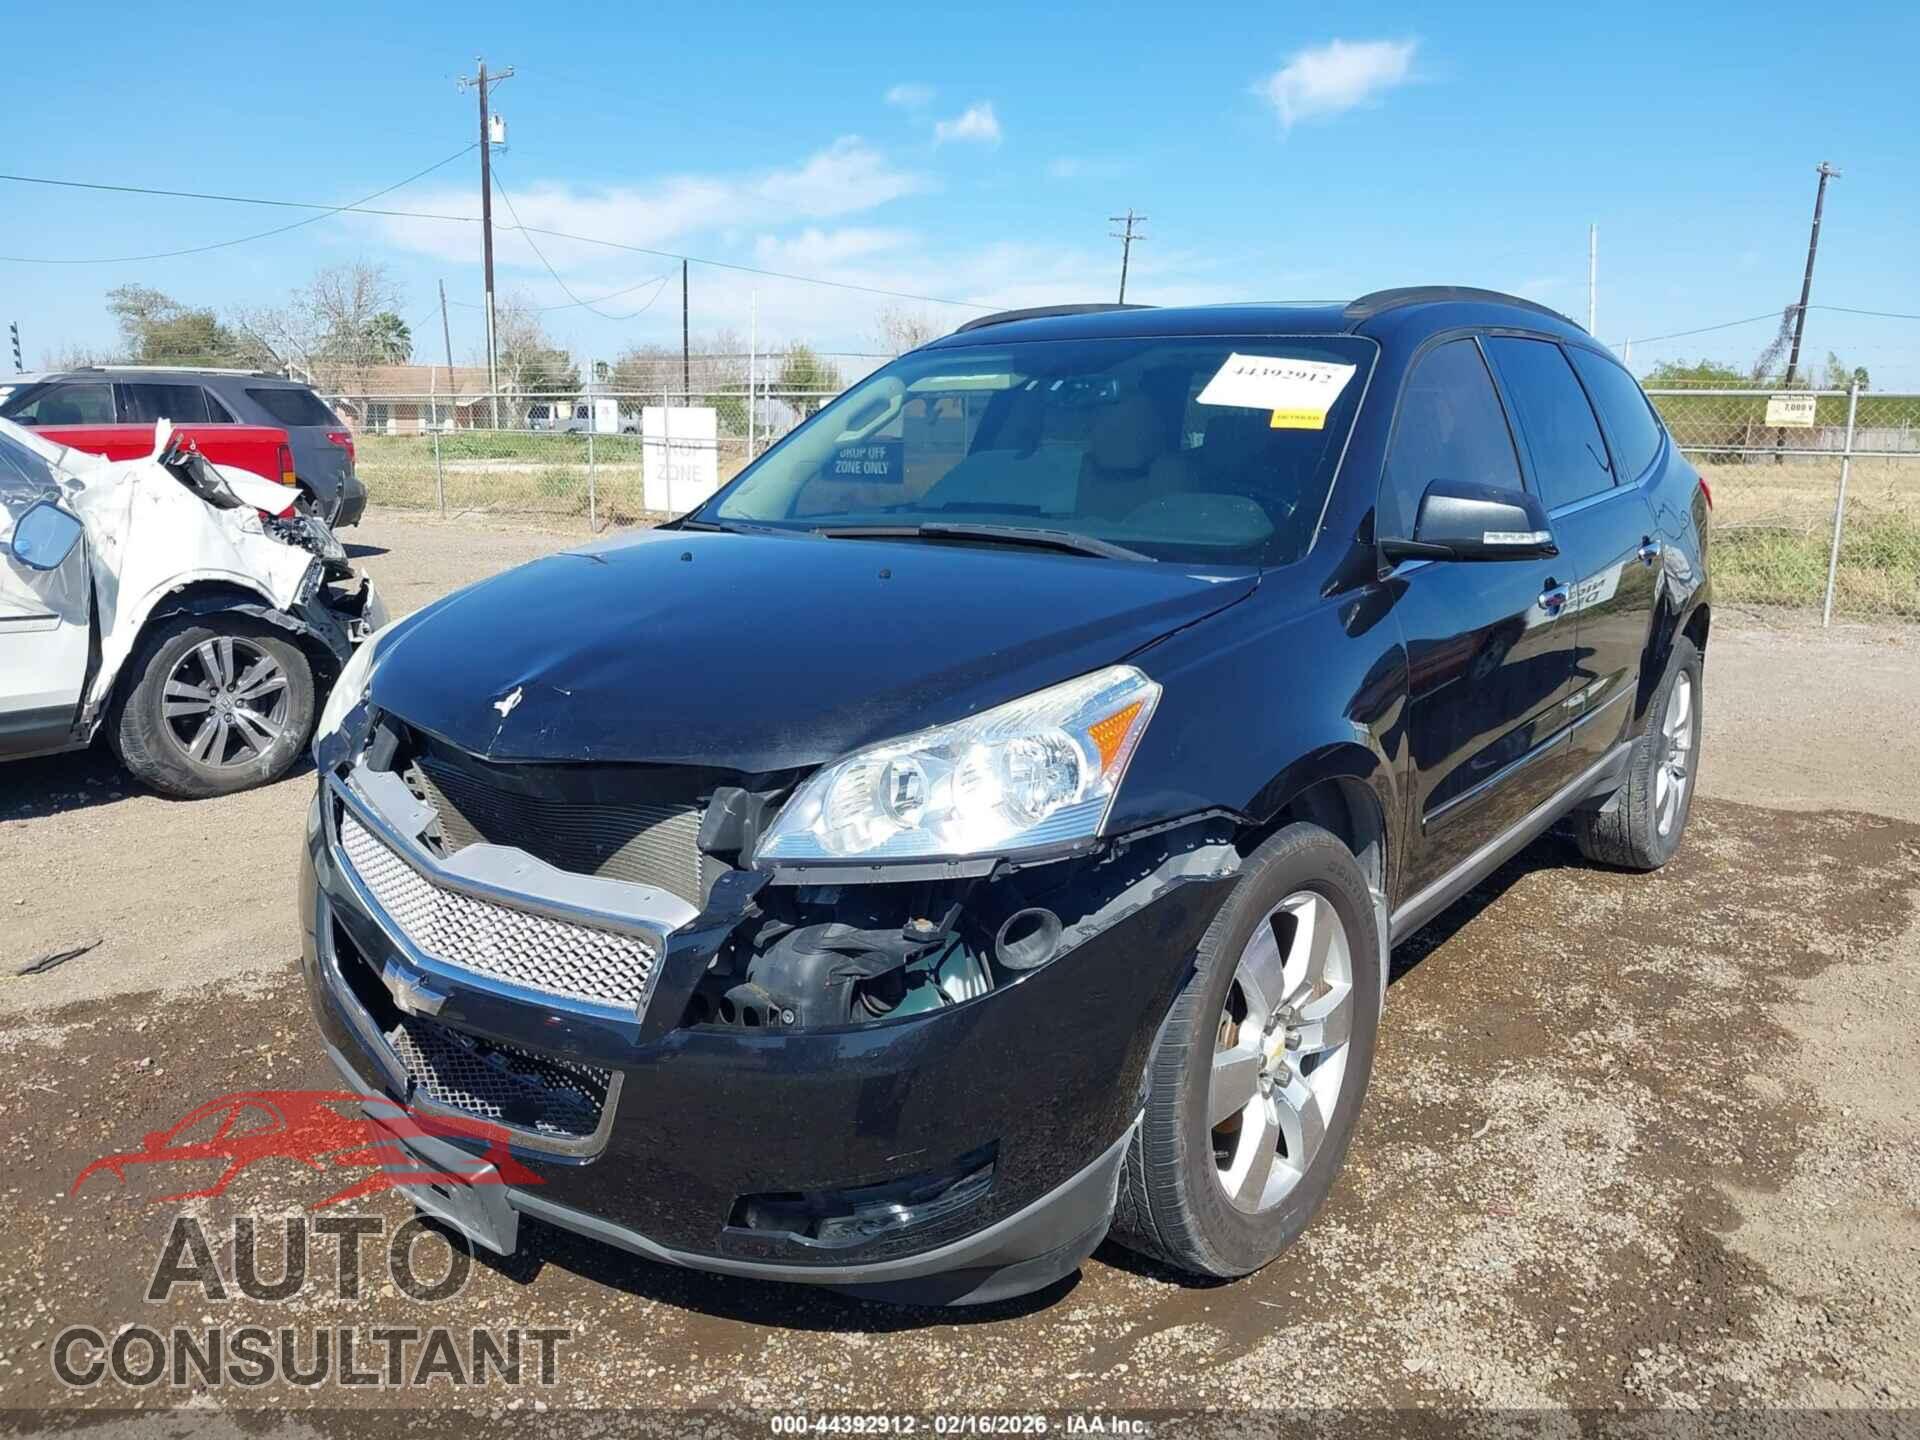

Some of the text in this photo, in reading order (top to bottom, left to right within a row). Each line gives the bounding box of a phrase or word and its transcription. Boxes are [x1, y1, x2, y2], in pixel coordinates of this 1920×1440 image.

[656, 440, 703, 456] DROP
[839, 447, 887, 460] DROP OFF
[656, 463, 704, 482] ZONE
[835, 460, 889, 475] ZONE ONLY
